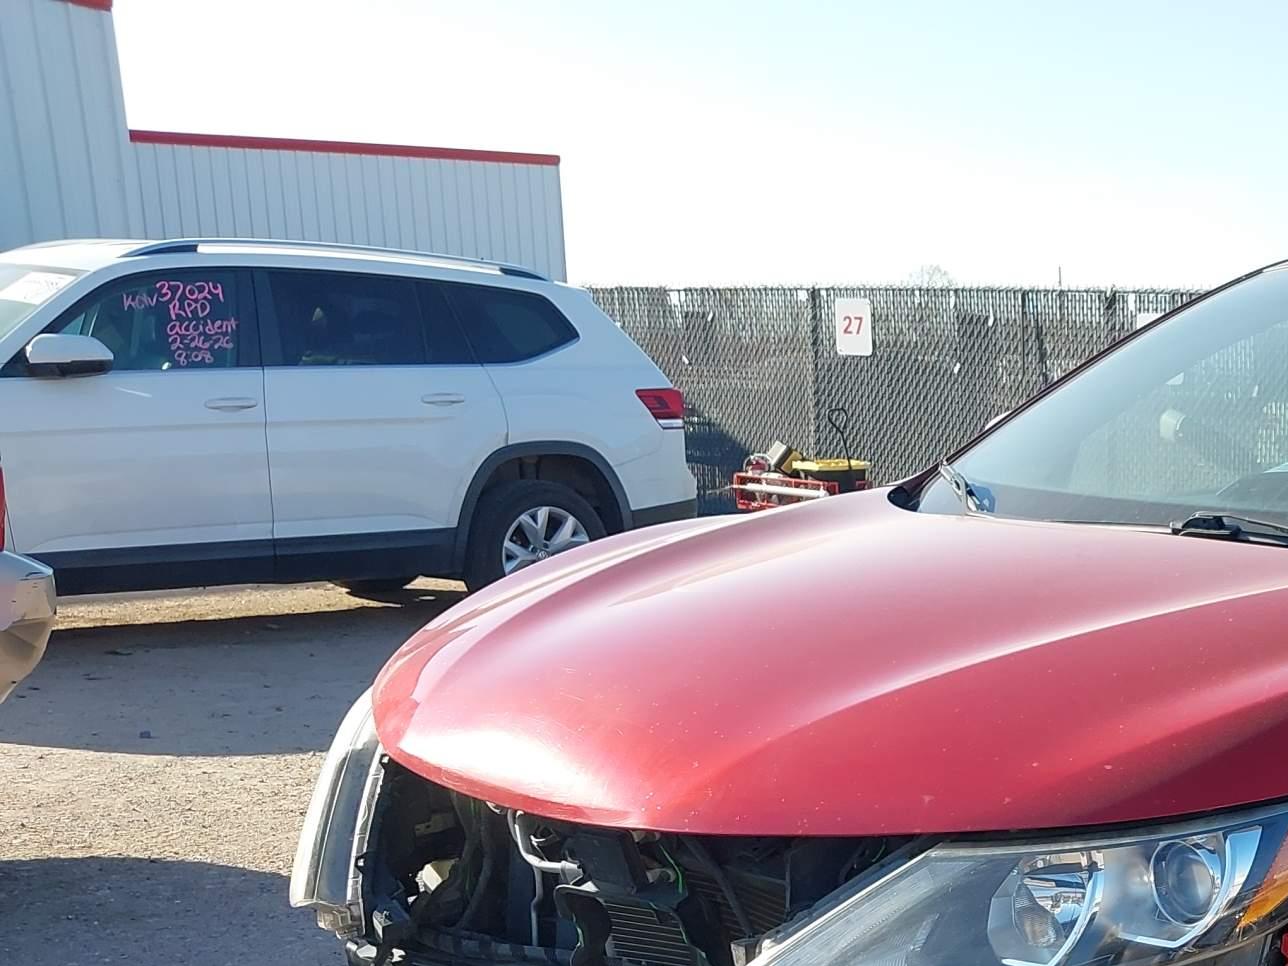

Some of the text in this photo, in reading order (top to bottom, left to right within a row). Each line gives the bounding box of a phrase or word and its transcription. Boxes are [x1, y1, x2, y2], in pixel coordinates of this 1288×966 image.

[156, 281, 225, 303] 37024
[168, 299, 211, 320] RPD
[167, 317, 238, 335] accident
[843, 315, 864, 335] 27
